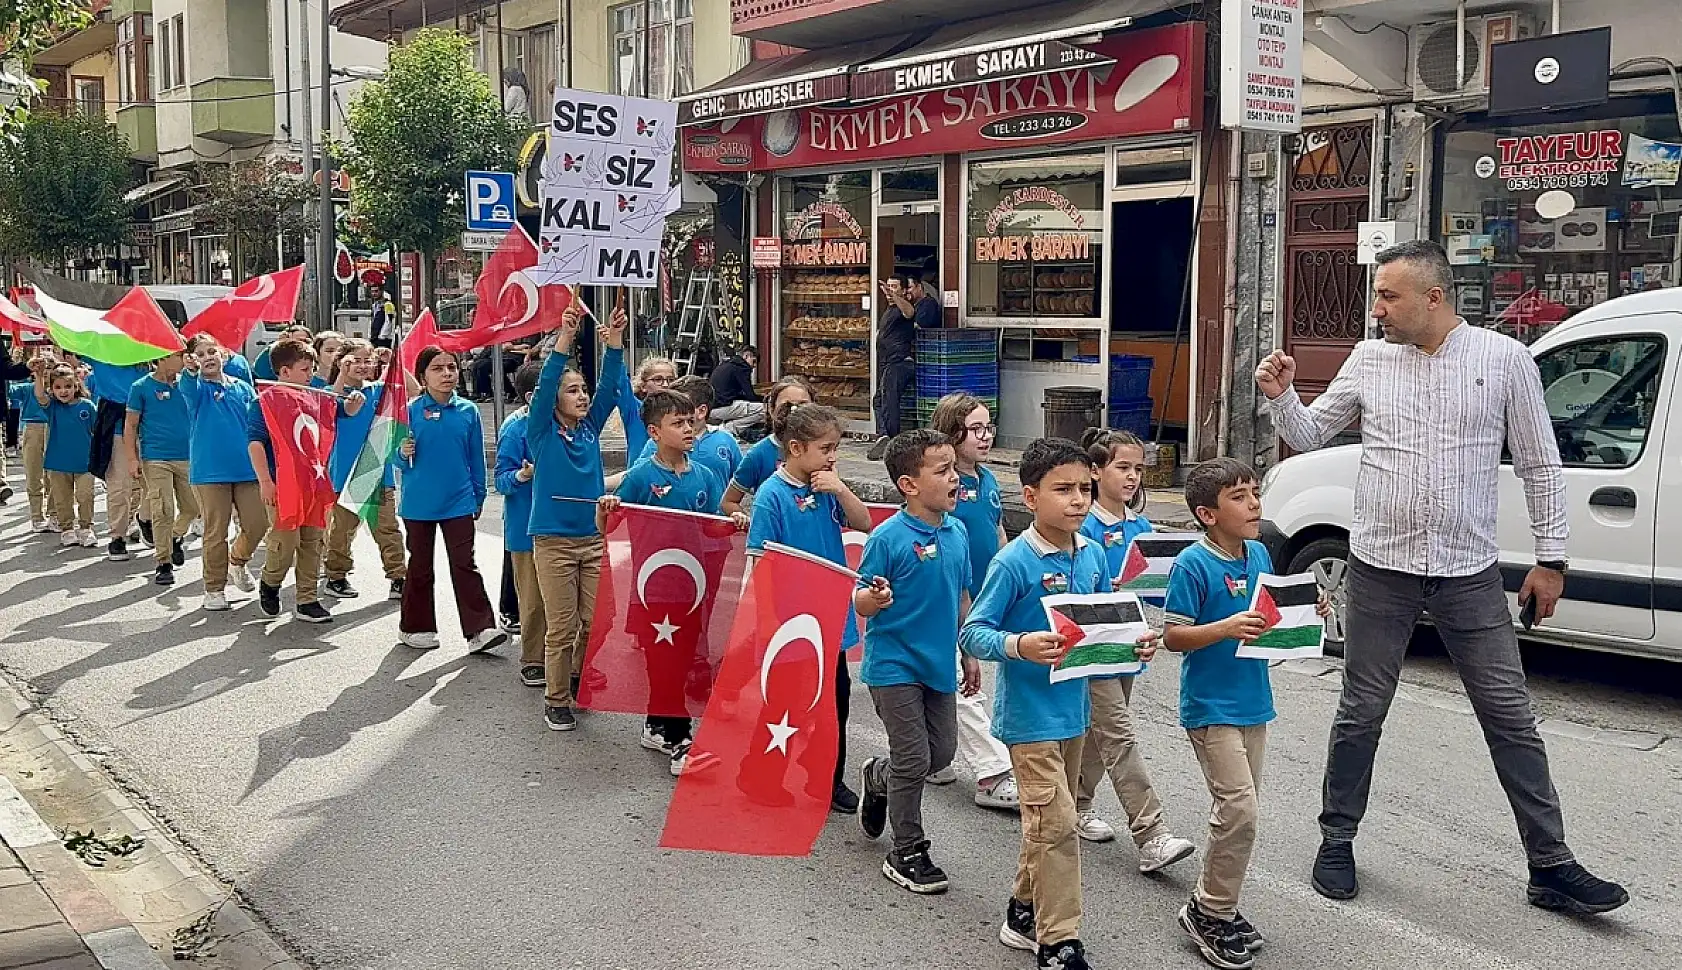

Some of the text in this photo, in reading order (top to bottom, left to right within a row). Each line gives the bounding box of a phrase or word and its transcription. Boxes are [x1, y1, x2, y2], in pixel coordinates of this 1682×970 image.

[1252, 5, 1292, 23] ÇANAK ANTEN
[1260, 22, 1285, 37] MONTAJI
[1258, 38, 1286, 54] OTO TEYP
[895, 61, 956, 92] EKMEK
[976, 43, 1045, 76] SARAYI
[1060, 51, 1073, 62] 233
[1074, 49, 1084, 60] 43
[1259, 55, 1284, 68] MONTAJI
[1247, 72, 1267, 84] SAMET
[692, 79, 814, 118] GENÇ KARDEŞLER
[1247, 85, 1263, 96] 0534
[1286, 90, 1294, 100] 74
[809, 68, 1098, 151] EKMEK SARAYI
[1246, 99, 1268, 111] TAYFUR
[553, 100, 618, 137] SES
[993, 123, 1010, 135] TEL
[1019, 119, 1039, 133] 233
[1043, 117, 1055, 129] 43
[1058, 115, 1072, 128] 26
[1496, 129, 1622, 164] TAYFUR
[606, 149, 656, 189] SİZ
[1499, 157, 1617, 178] ELEKTRONİK
[1507, 173, 1608, 190] 0534 796 95 74
[470, 177, 501, 220] P
[543, 197, 611, 232] KAL
[783, 242, 821, 265] EKMEK
[824, 242, 867, 264] SARAYI
[975, 234, 1089, 261] EKMEK SARAYI
[597, 248, 656, 278] MA!
